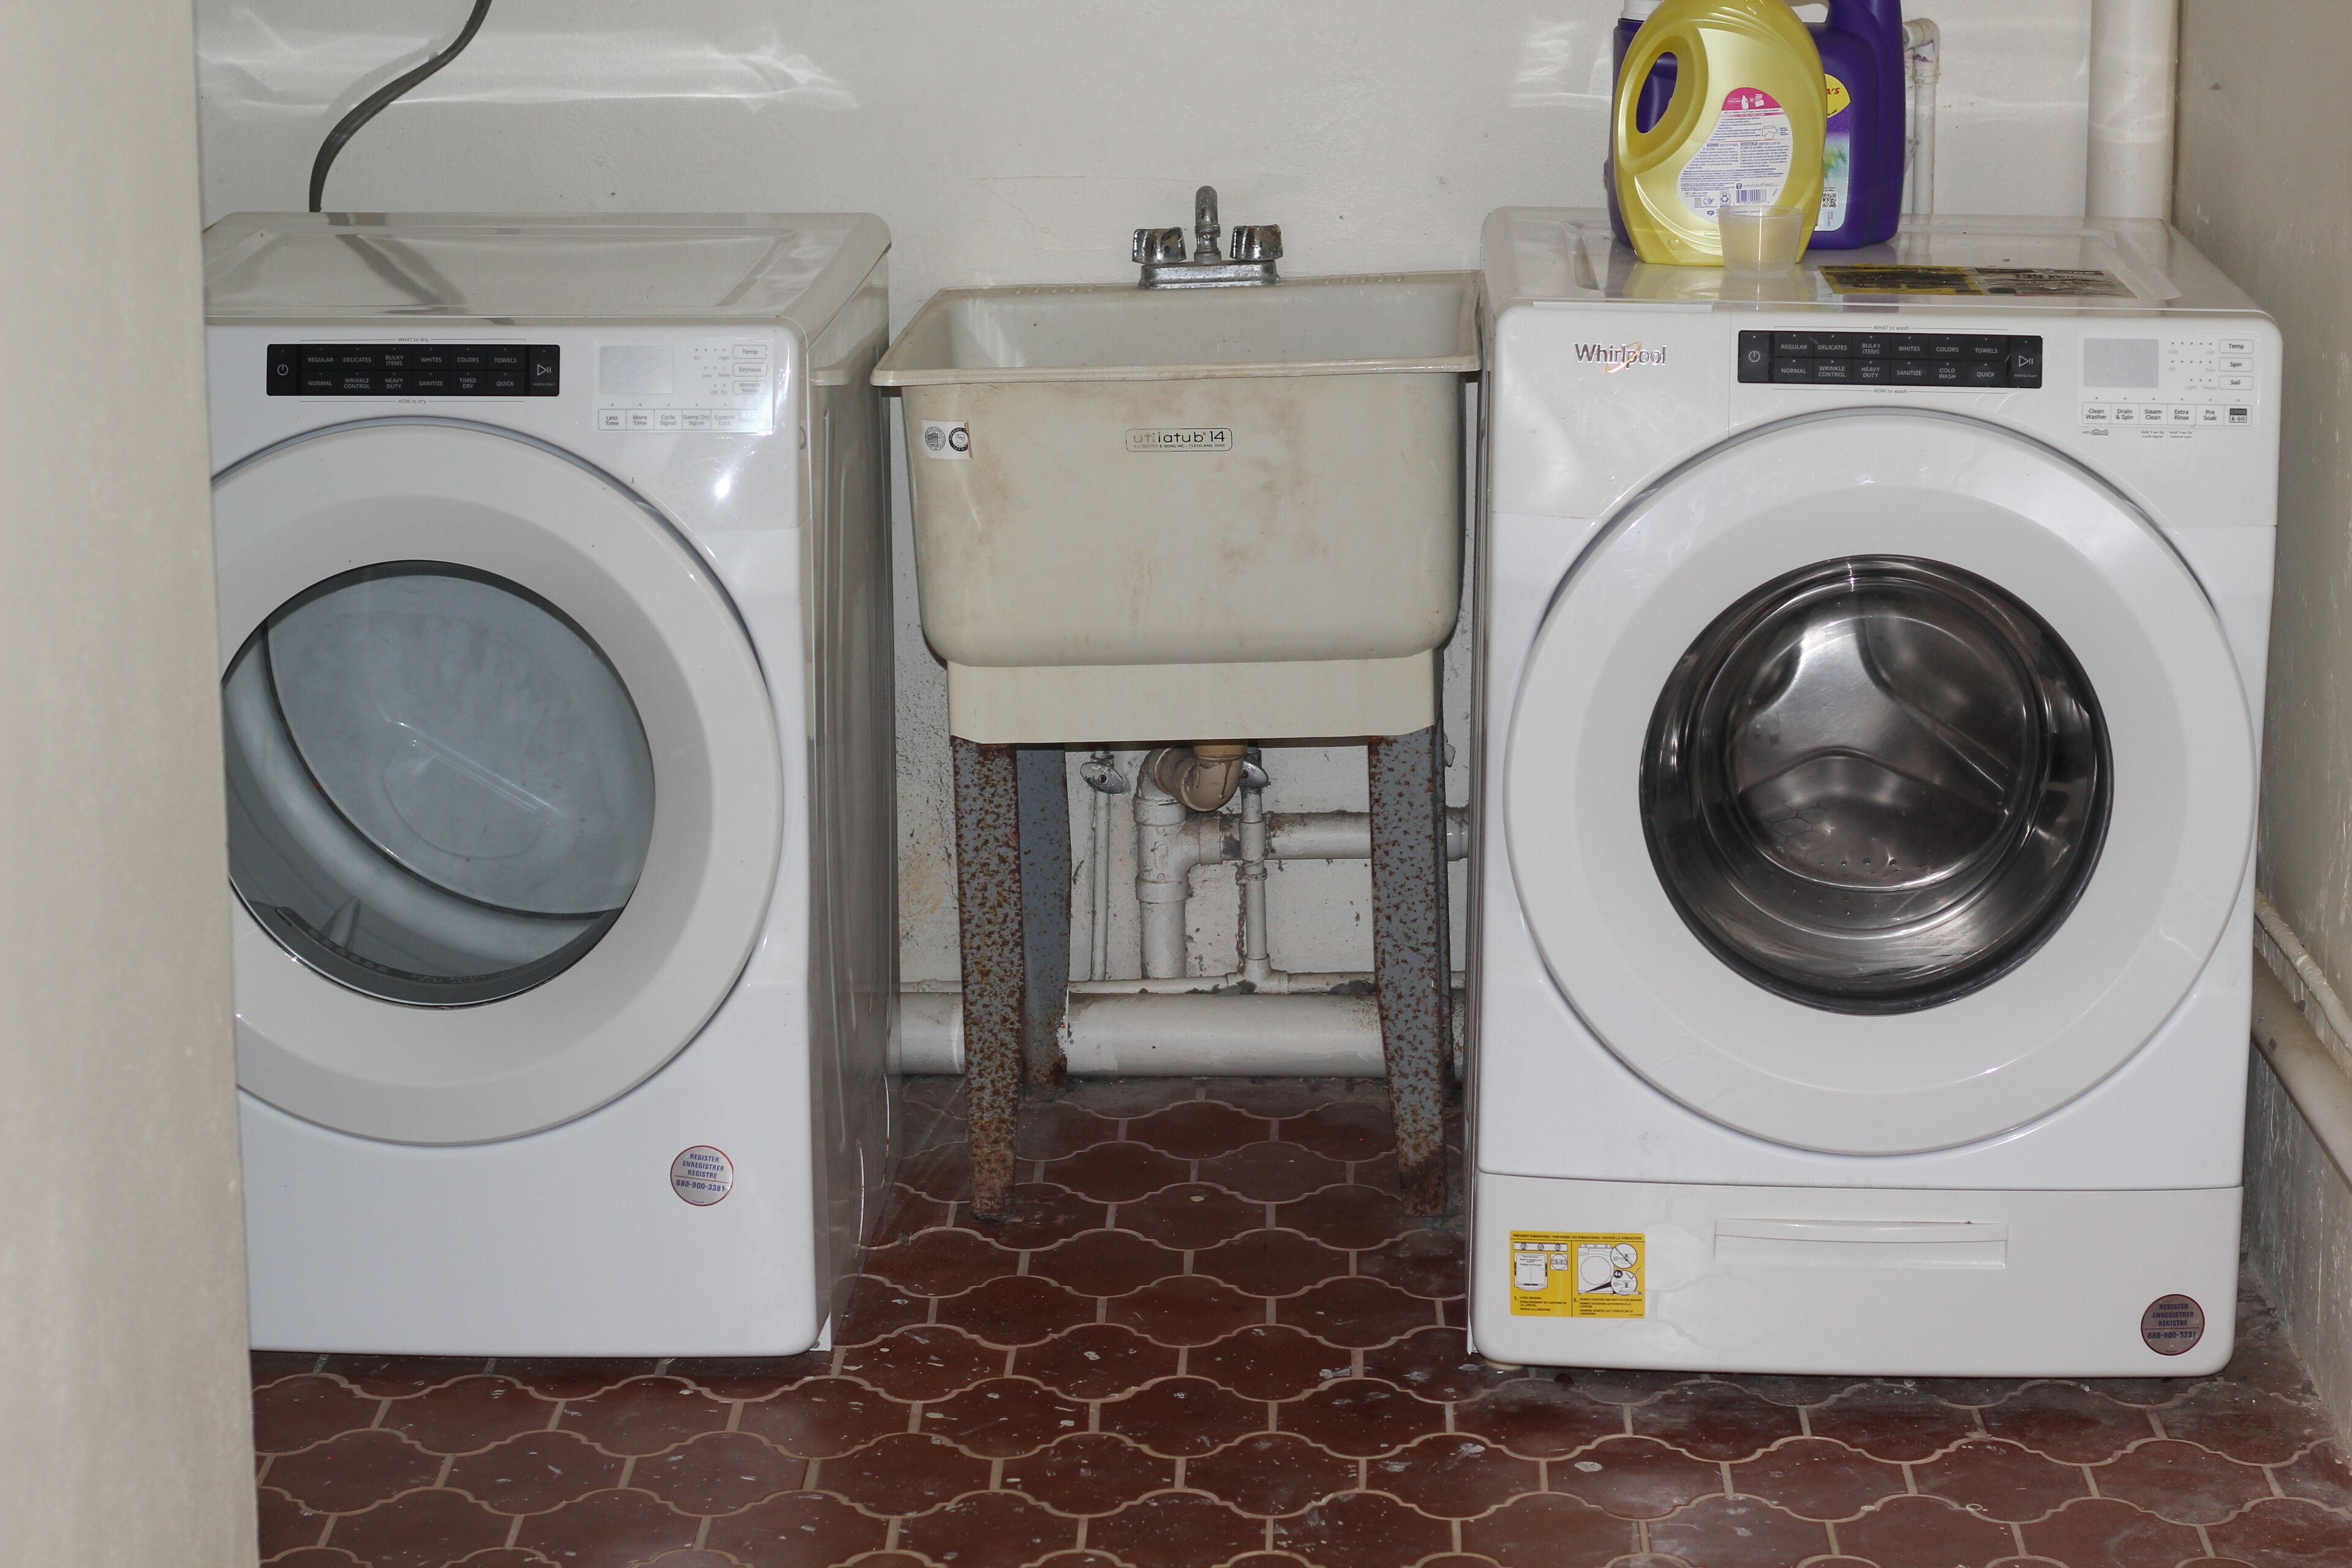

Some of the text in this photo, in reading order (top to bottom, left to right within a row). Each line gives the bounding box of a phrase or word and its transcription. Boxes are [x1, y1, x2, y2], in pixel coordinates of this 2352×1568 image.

[1574, 342, 1667, 370] Whirlpool
[1210, 431, 1225, 442] 14
[690, 1153, 720, 1163] REGISTER
[682, 1160, 725, 1172] ENREGISTRER
[687, 1169, 717, 1179] REGISTRE
[676, 1179, 725, 1193] 888-900-3381
